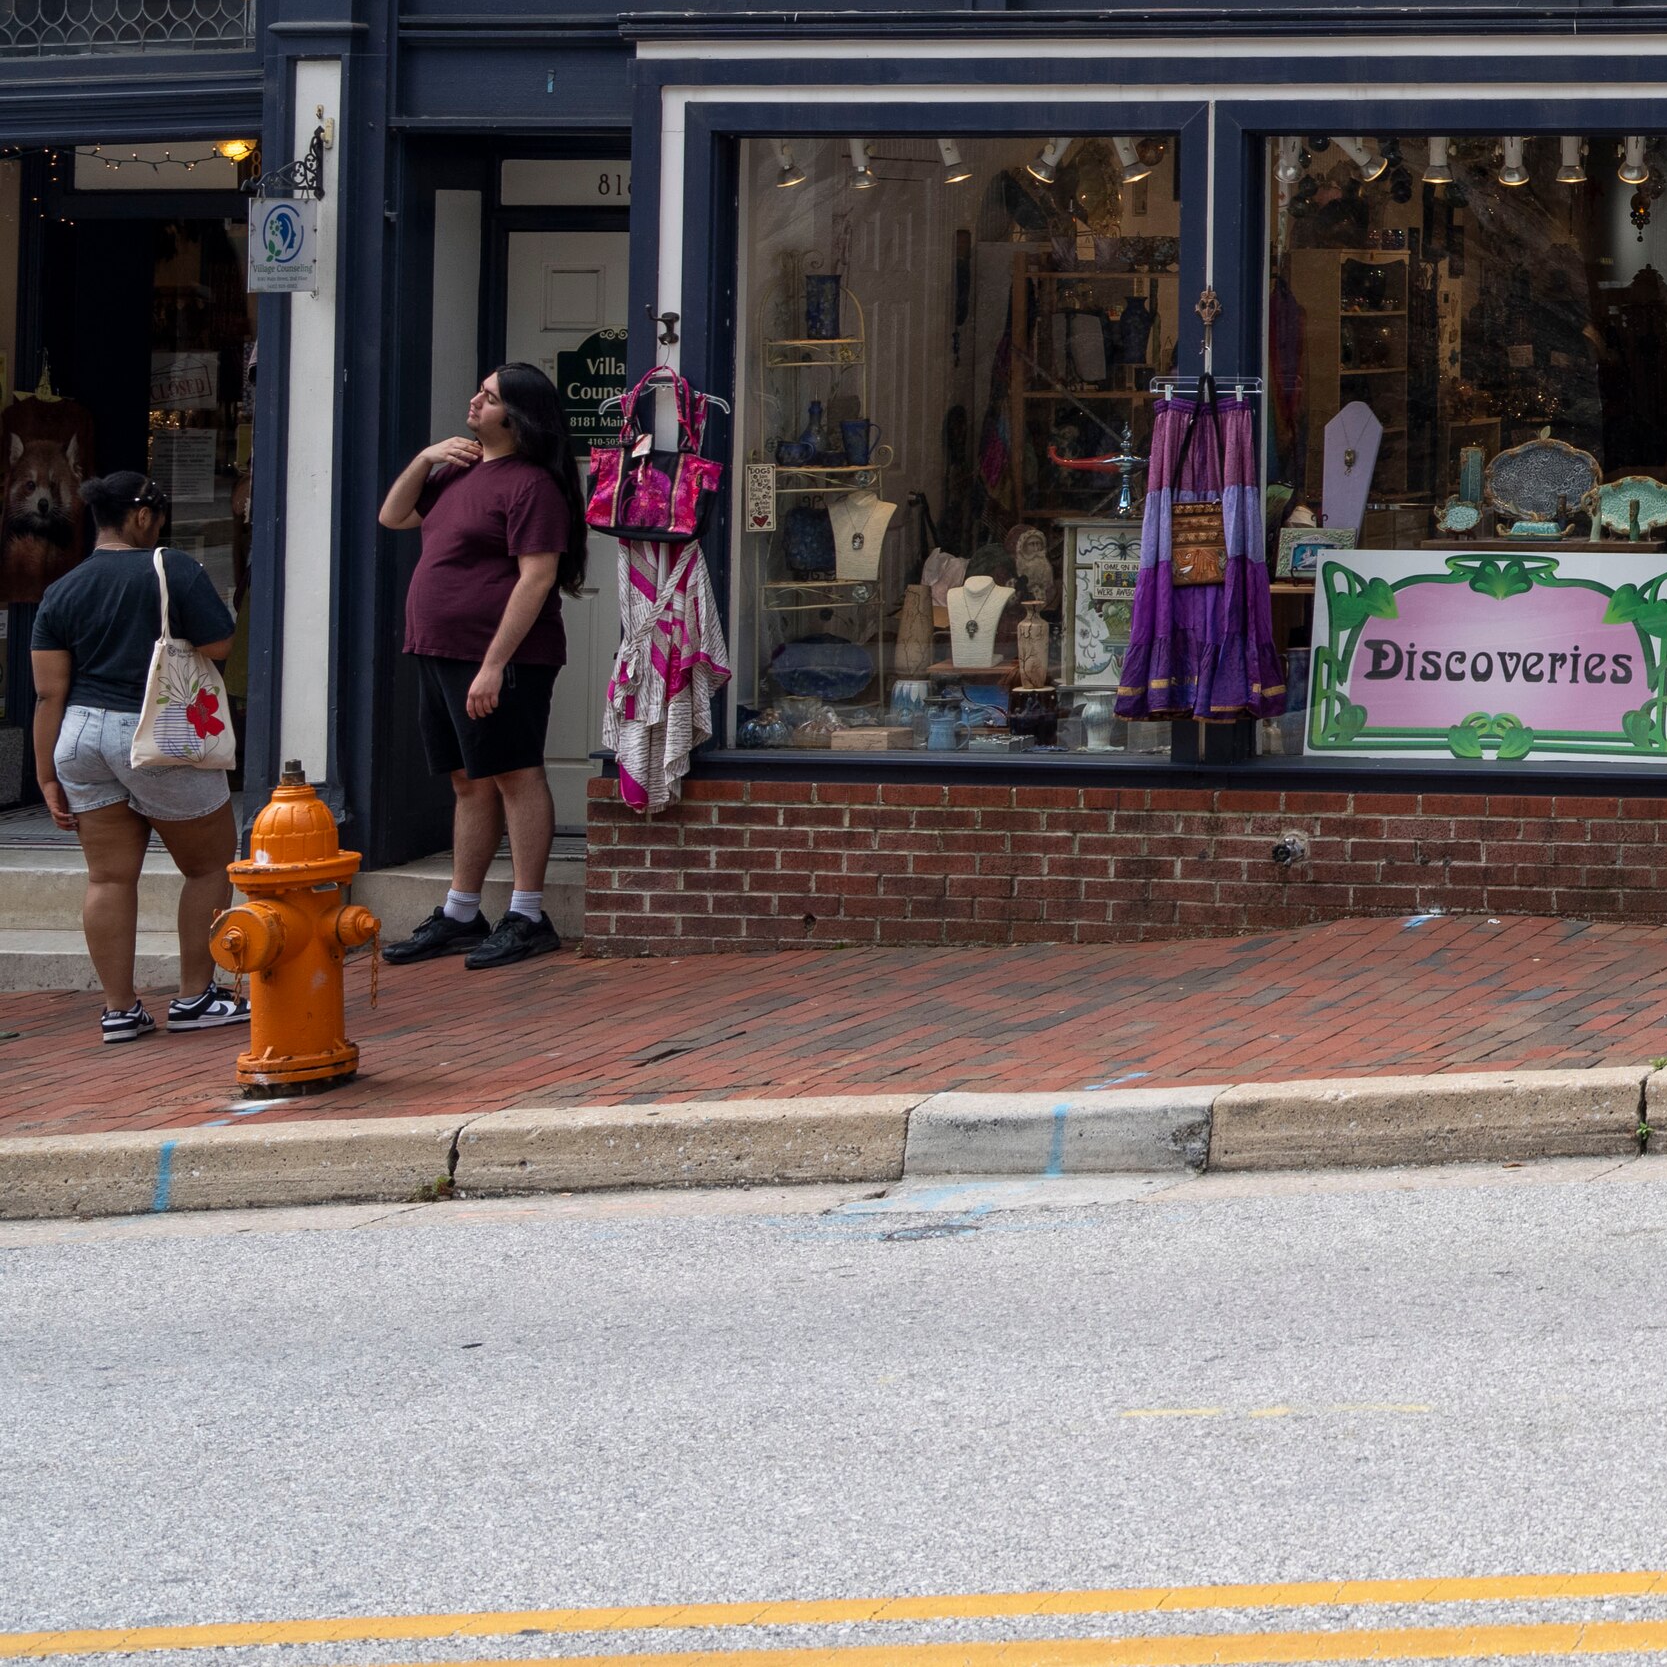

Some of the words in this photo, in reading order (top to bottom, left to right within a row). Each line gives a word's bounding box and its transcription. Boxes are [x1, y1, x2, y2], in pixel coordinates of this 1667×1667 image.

[598, 173, 632, 196] 81
[253, 264, 276, 274] Village
[277, 264, 313, 274] Counseling
[586, 357, 626, 375] Villa
[151, 378, 205, 401] CLOSED
[569, 417, 596, 427] 8181
[1363, 639, 1634, 686] Discoveries
